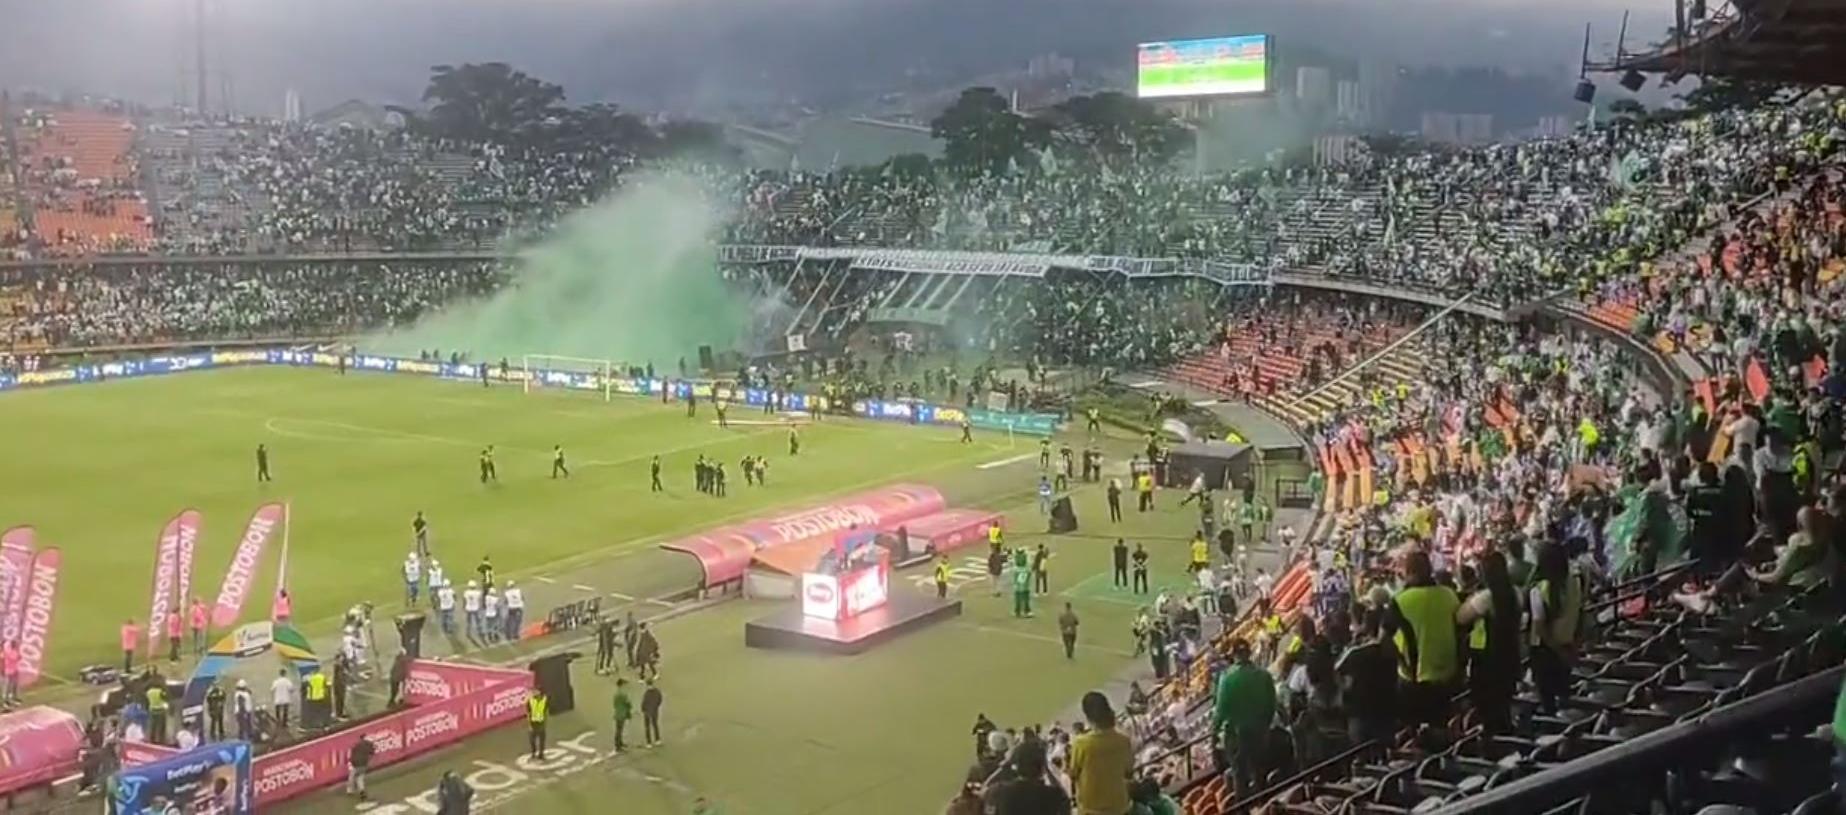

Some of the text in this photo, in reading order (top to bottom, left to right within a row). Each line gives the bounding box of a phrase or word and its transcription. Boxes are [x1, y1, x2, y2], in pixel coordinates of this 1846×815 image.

[217, 517, 276, 609] POSTOBON
[18, 564, 57, 675] POSTOBON
[485, 688, 529, 719] POSTOBO
[254, 763, 316, 797] POSTOBON
